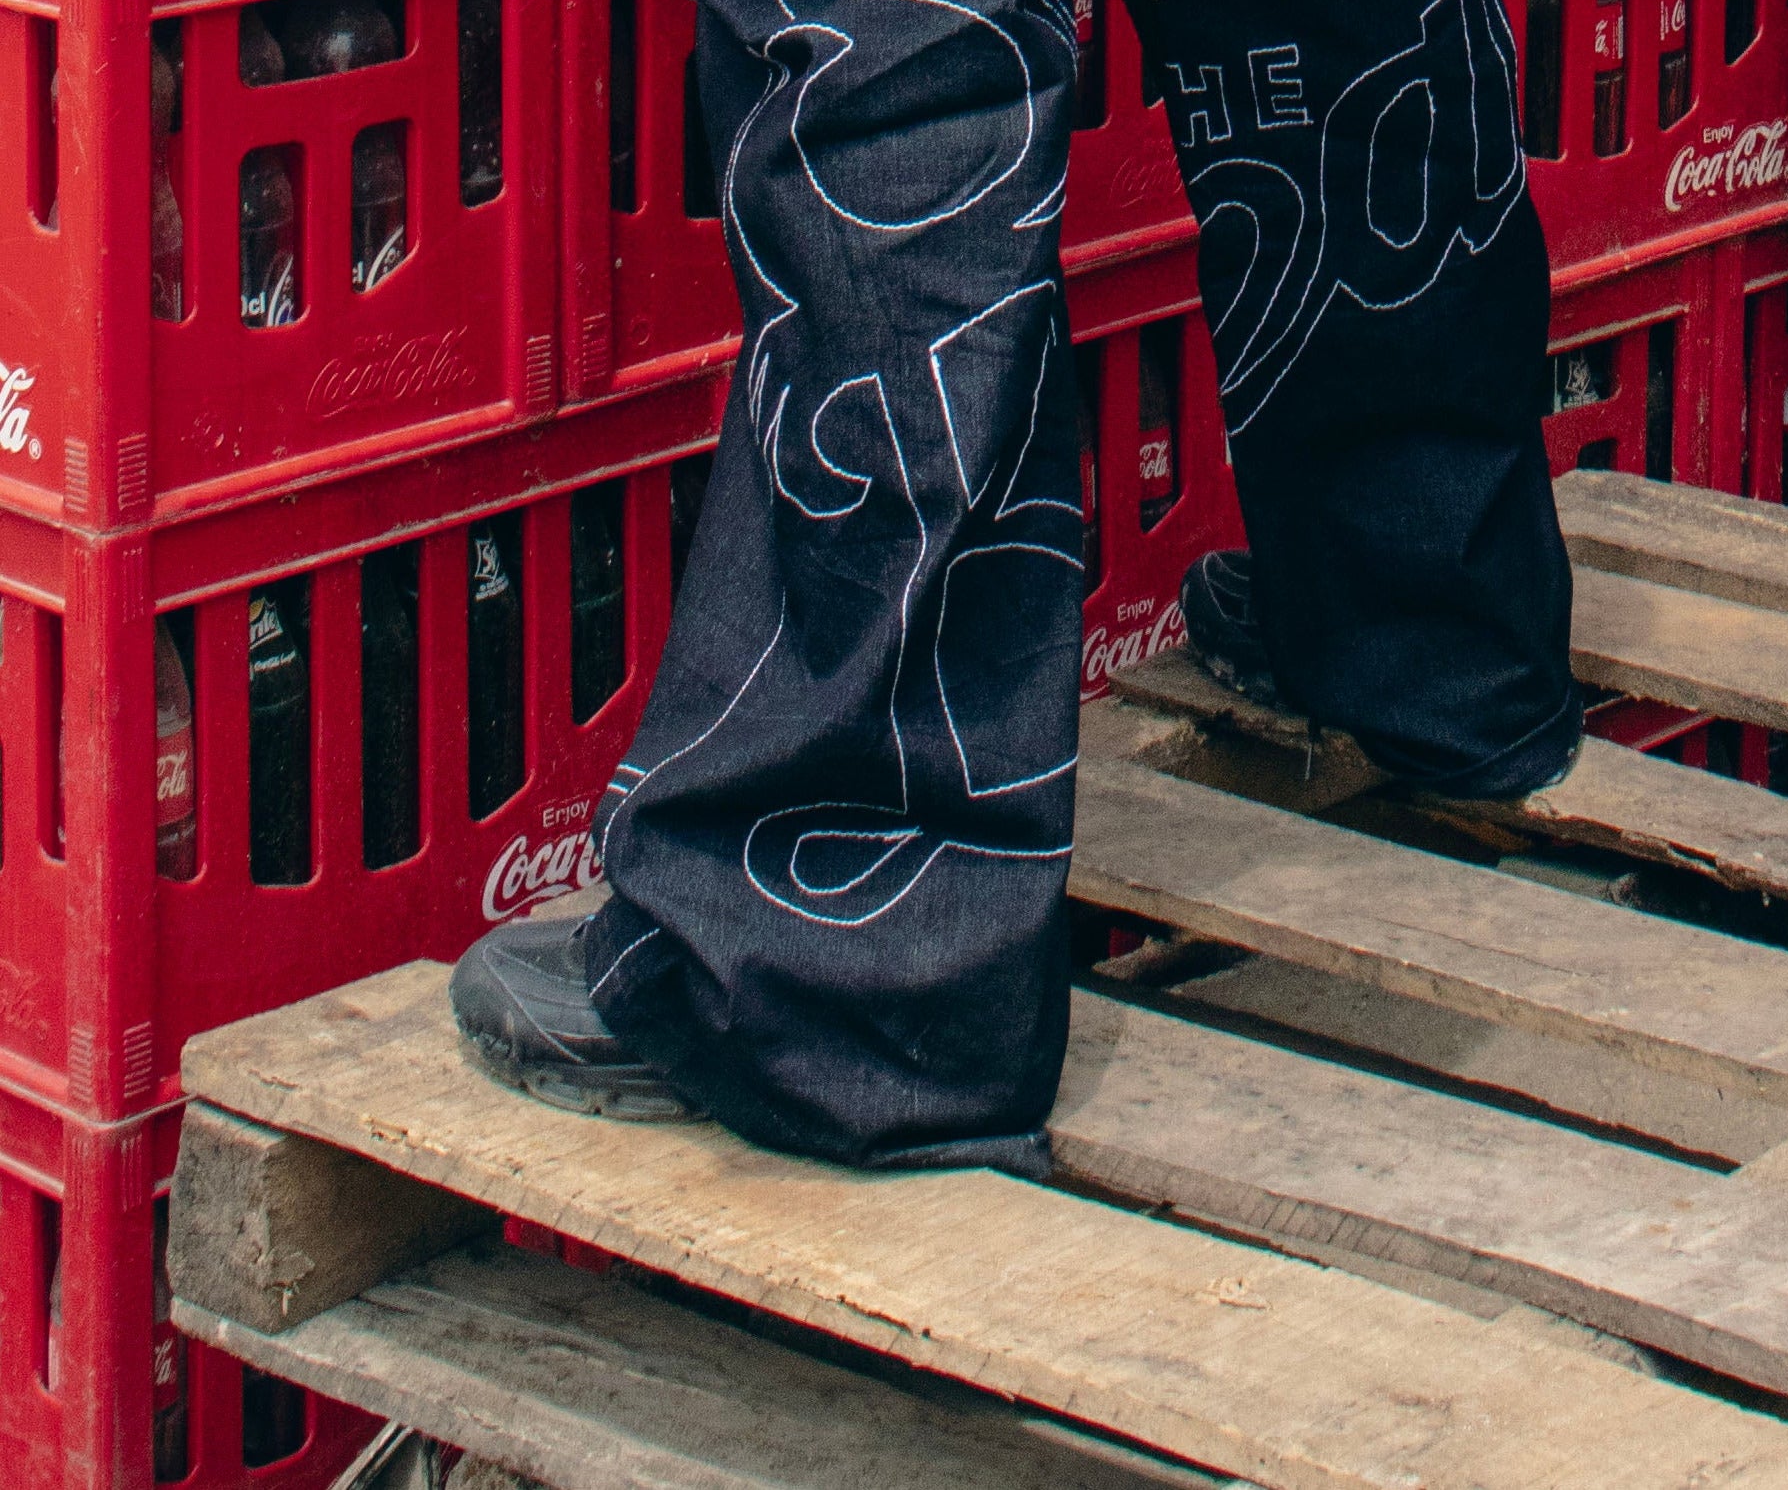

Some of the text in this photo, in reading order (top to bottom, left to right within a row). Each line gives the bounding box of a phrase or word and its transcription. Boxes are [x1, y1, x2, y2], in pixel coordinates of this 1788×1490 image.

[1703, 125, 1735, 143] Enjoy
[1665, 121, 1786, 211] Coca-Cola
[1117, 598, 1155, 621] Enjoy
